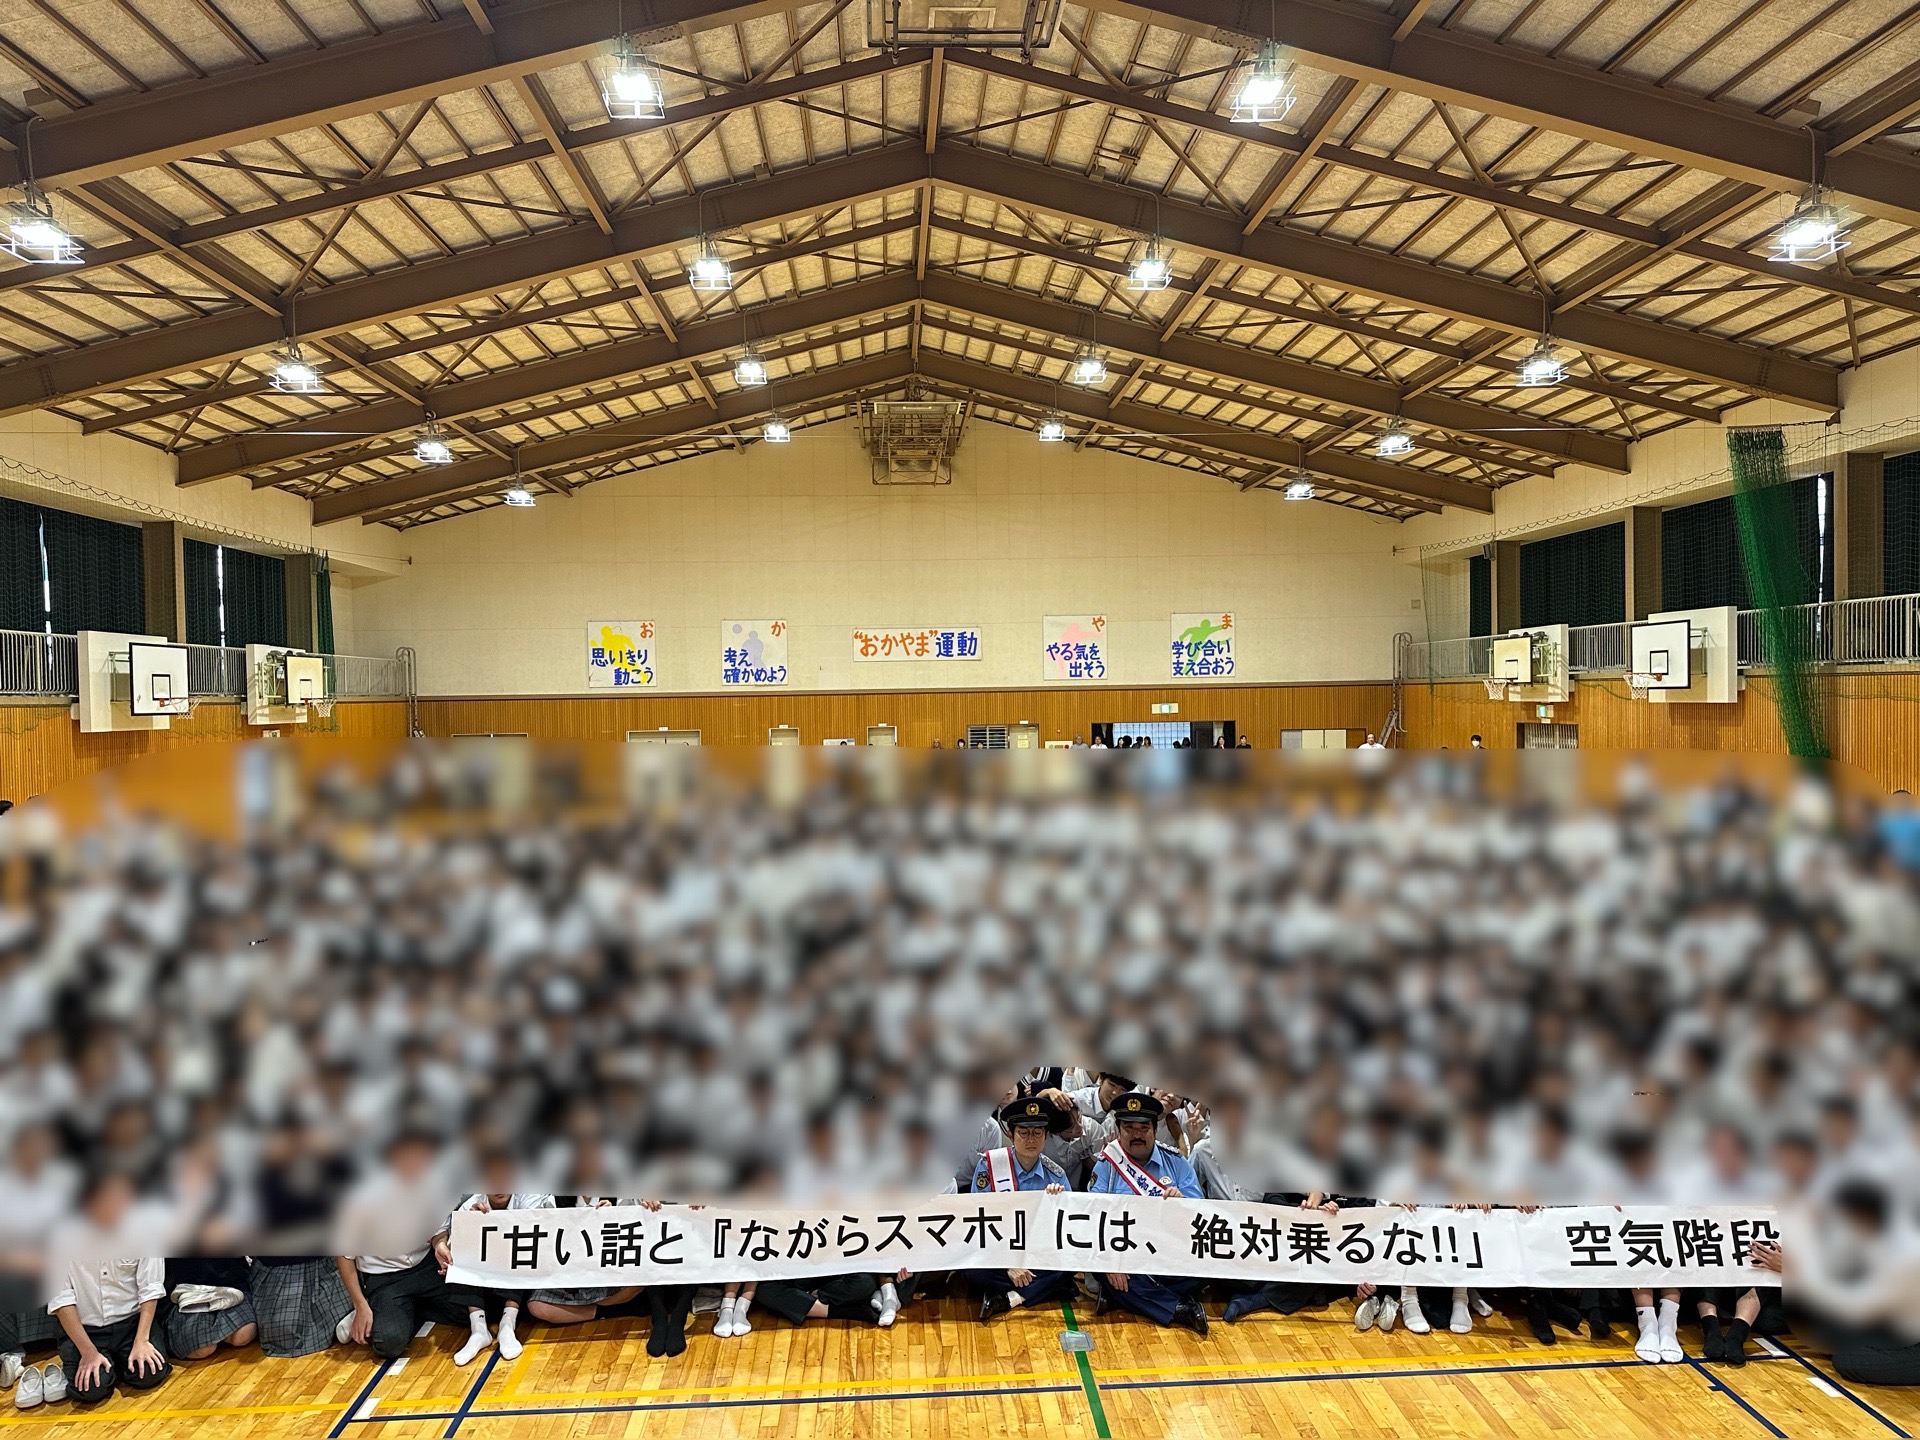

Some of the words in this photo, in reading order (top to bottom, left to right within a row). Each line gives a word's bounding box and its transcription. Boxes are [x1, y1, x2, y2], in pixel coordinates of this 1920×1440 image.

[640, 622, 654, 638] お
[770, 621, 786, 637] か
[1091, 616, 1106, 632] や
[1221, 613, 1233, 630] ま
[591, 647, 648, 667] 思いきり
[723, 647, 752, 667] 考え
[1045, 642, 1100, 661] やる気を
[1171, 639, 1231, 659] 学び合い
[723, 665, 787, 683] 確かめよう
[1069, 660, 1105, 678] 出そう
[1172, 656, 1235, 677] 支え合おう
[613, 667, 654, 686] 動こう
[1565, 1218, 1780, 1269] 空気階段
